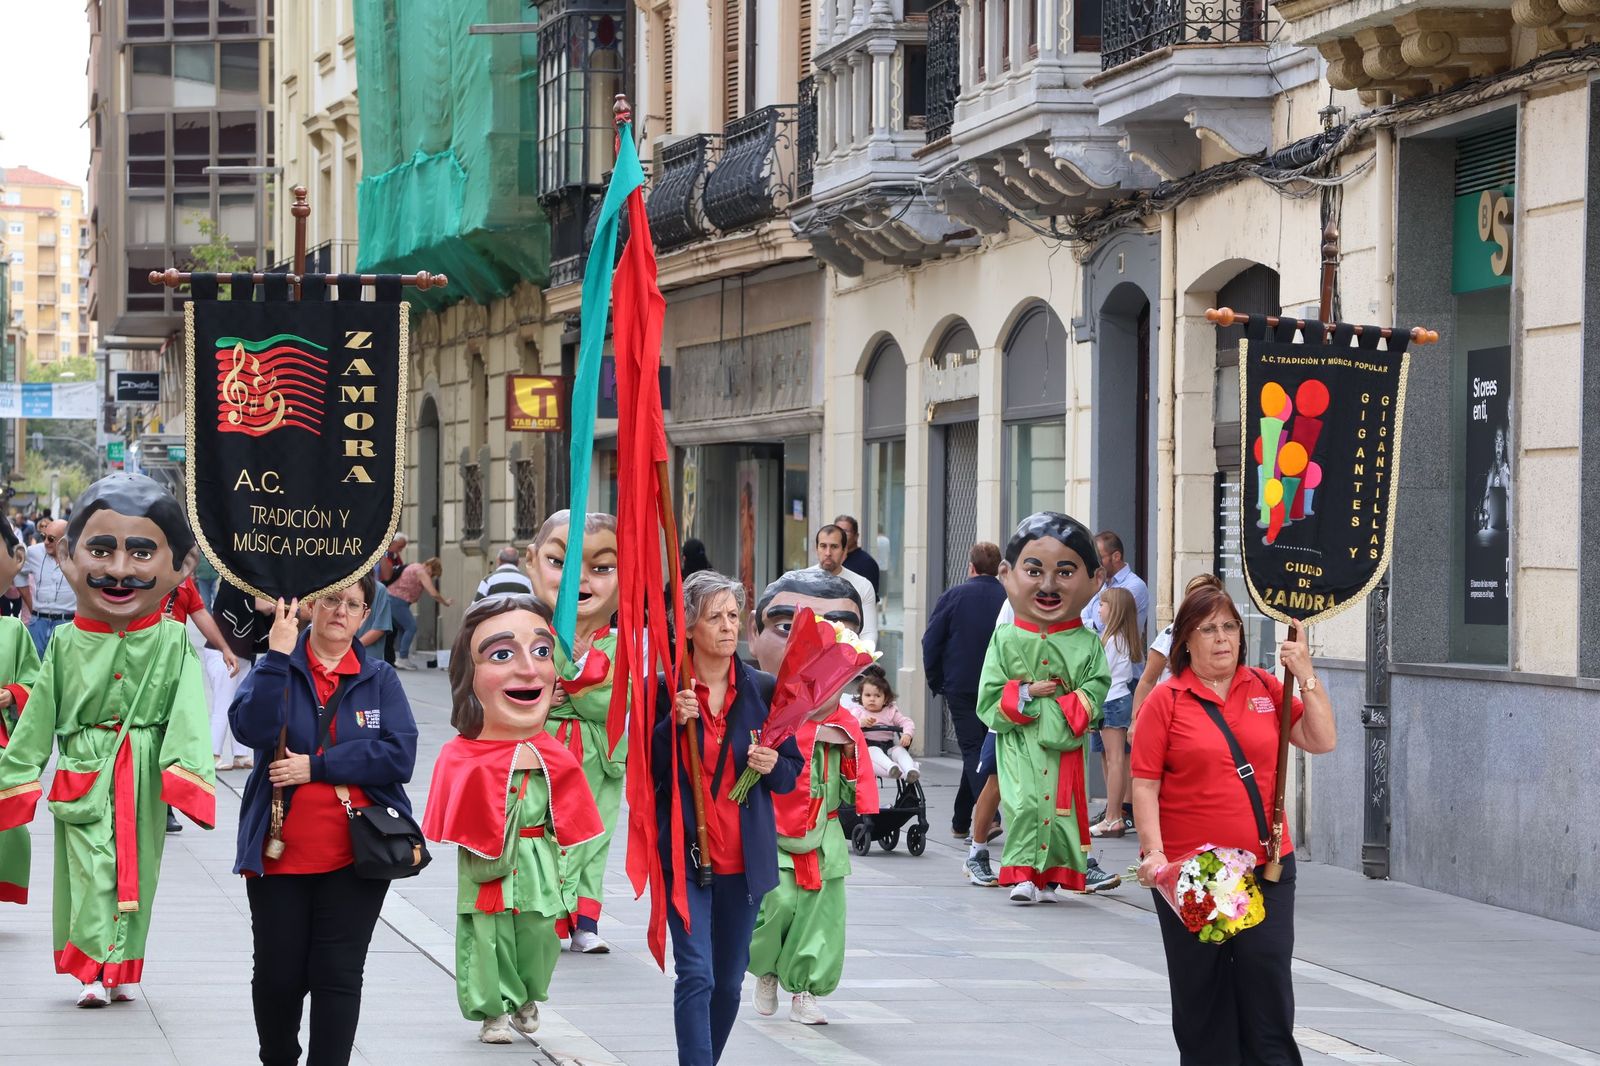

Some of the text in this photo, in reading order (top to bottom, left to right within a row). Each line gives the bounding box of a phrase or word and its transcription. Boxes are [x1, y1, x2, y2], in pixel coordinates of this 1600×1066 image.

[1354, 361, 1389, 373] POPULAR
[338, 330, 379, 483] ZAMORA
[513, 418, 557, 427] TABACOS
[233, 469, 285, 494] A.C.
[1349, 392, 1370, 559] GIGANTES Y
[1369, 395, 1390, 559] GIGANTILLAS
[249, 504, 350, 529] TRADICIÓN Y
[233, 528, 363, 556] MÚSICA POPULAR
[1298, 578, 1312, 589] DE
[1263, 588, 1337, 611] ZAMORA
